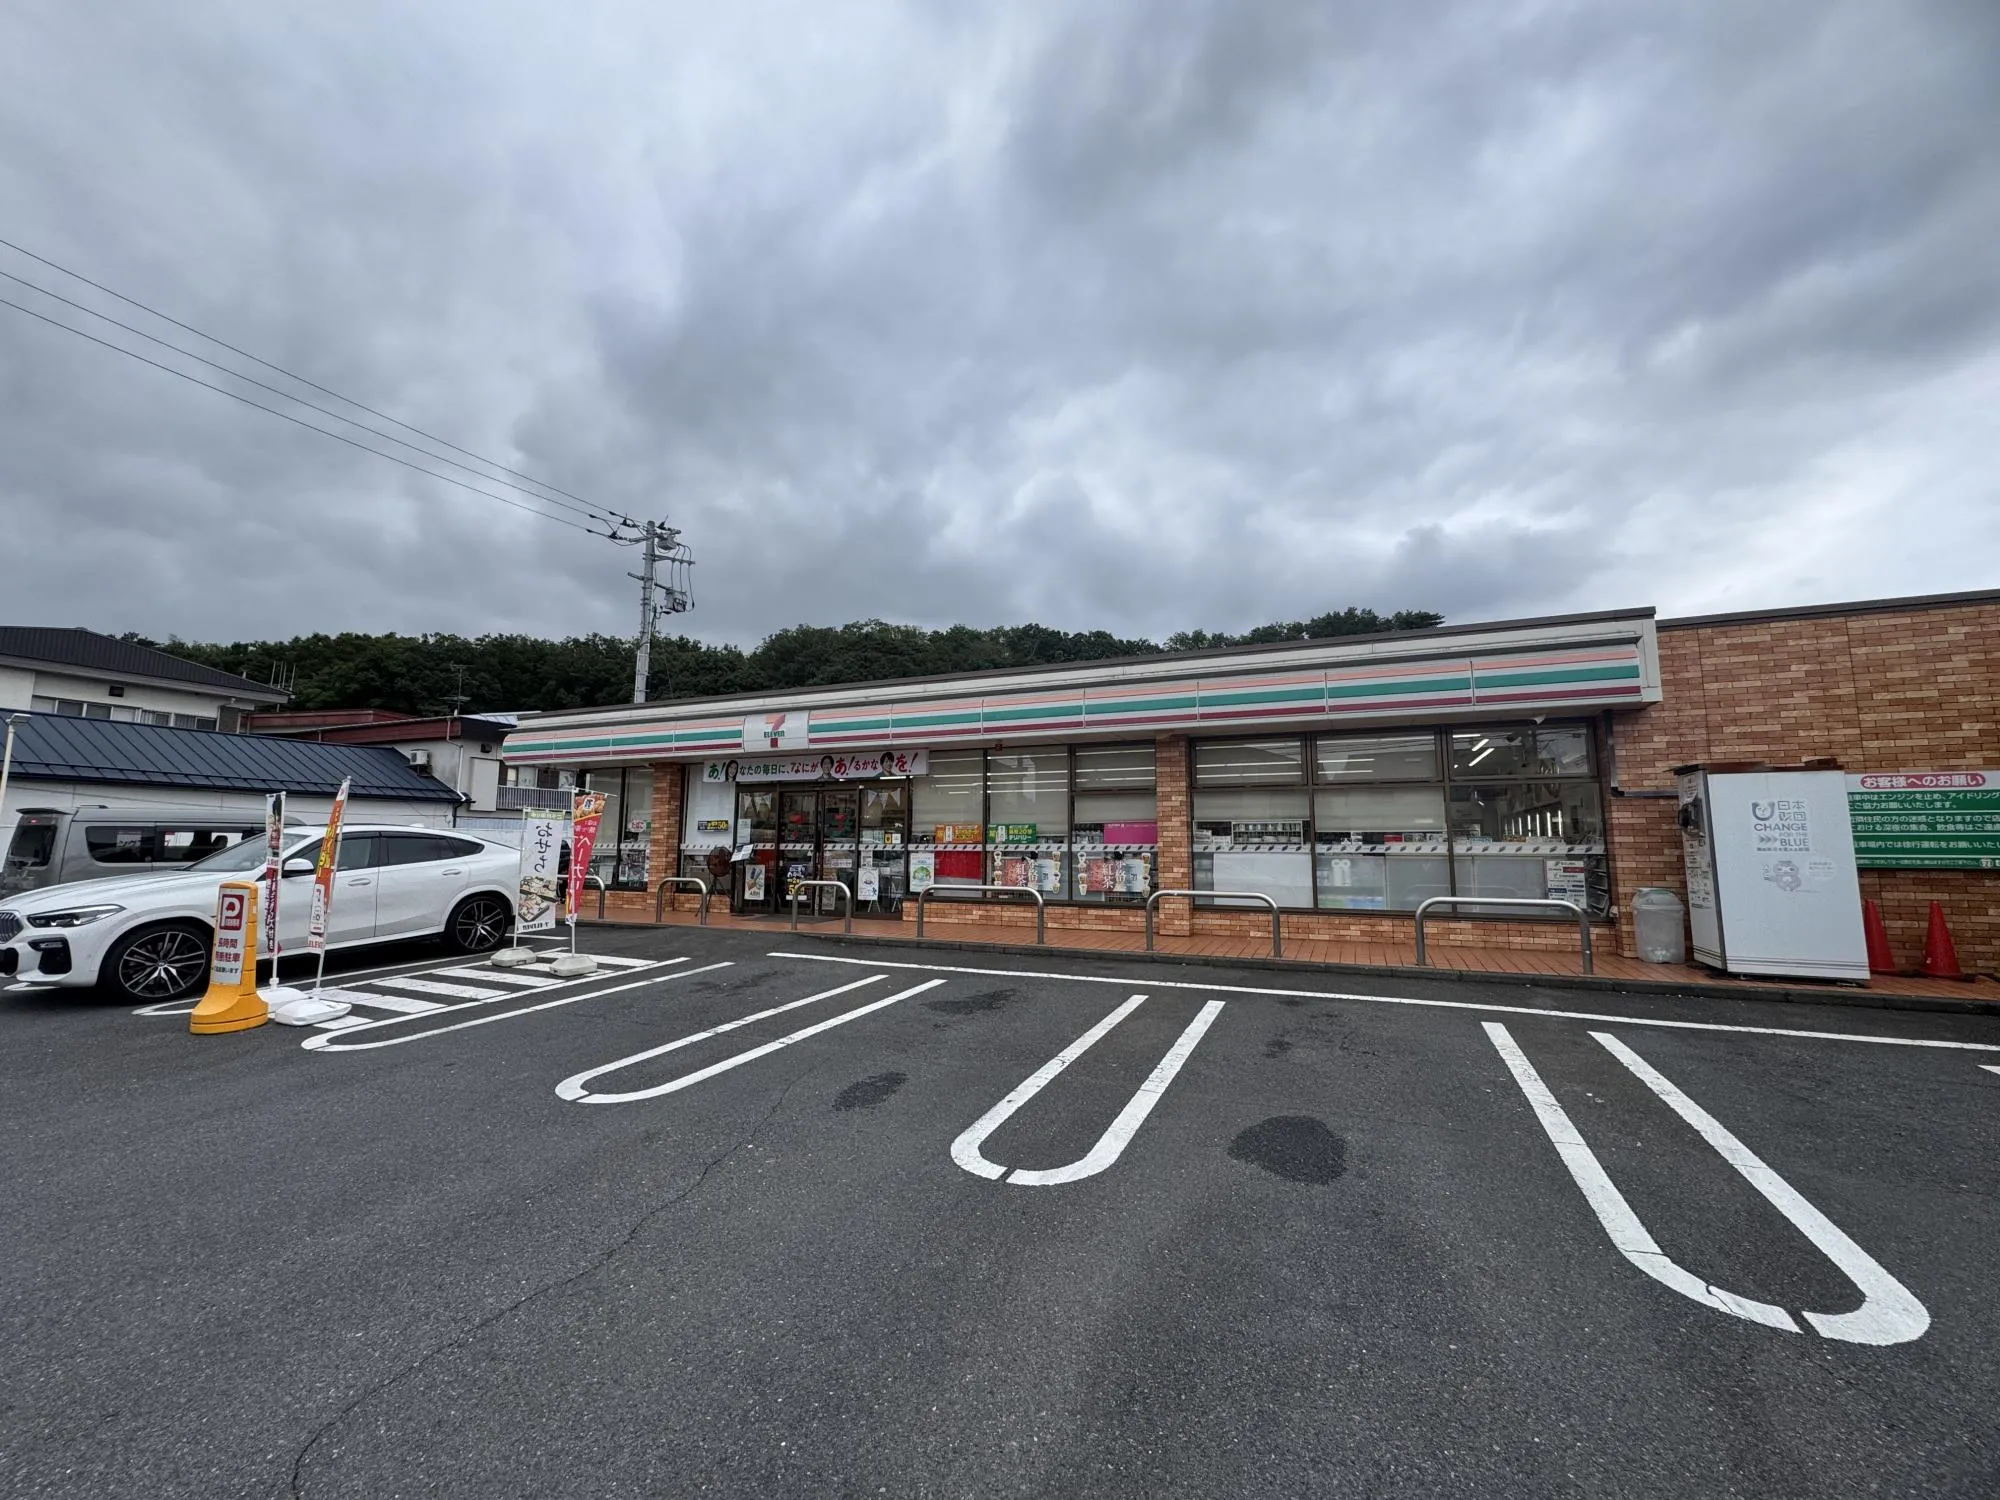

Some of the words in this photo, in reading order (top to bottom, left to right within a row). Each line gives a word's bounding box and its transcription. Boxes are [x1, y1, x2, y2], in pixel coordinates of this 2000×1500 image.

[1863, 775, 1984, 787] お客様へのお願い
[1754, 823, 1808, 832] CHANGE
[1780, 838, 1809, 847] BLUE
[1102, 863, 1114, 888] 紅茶
